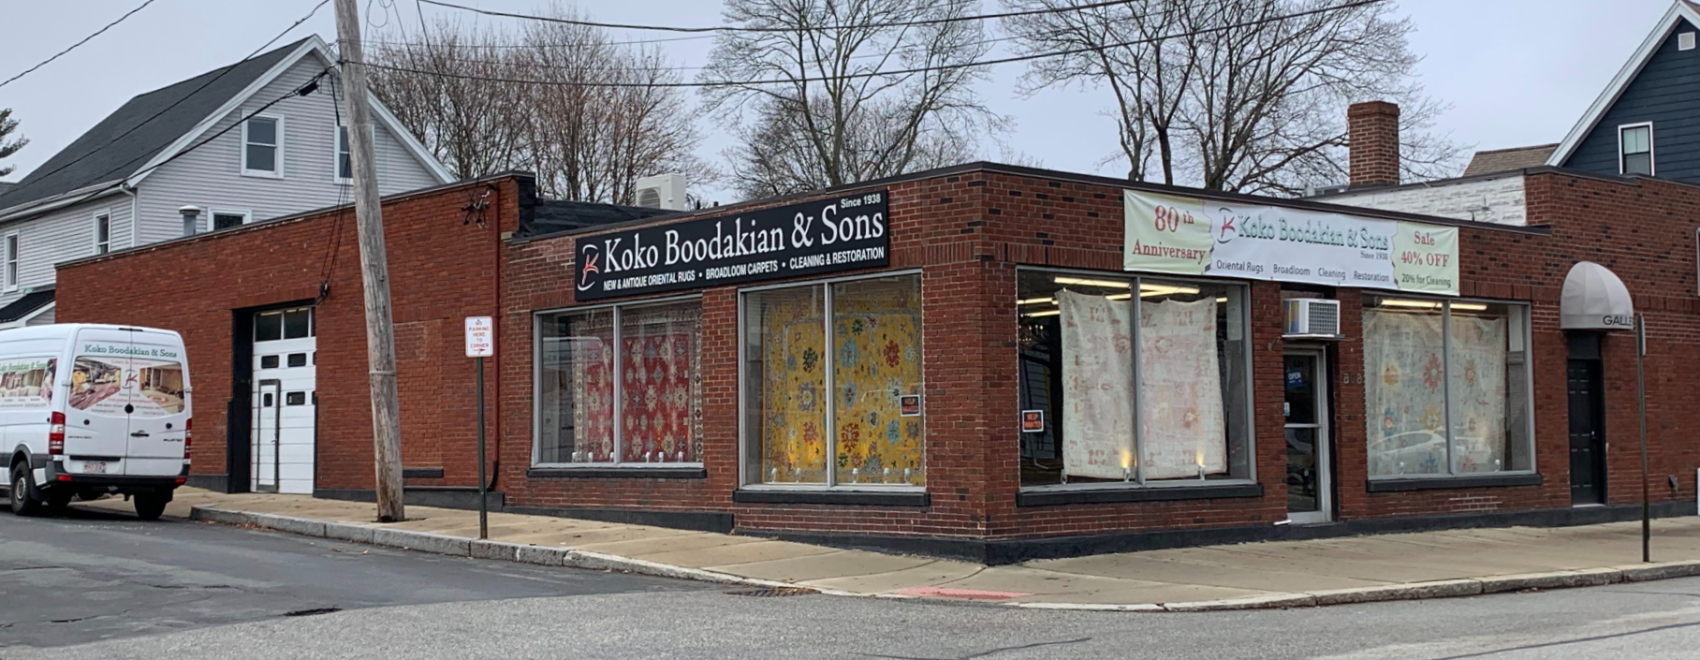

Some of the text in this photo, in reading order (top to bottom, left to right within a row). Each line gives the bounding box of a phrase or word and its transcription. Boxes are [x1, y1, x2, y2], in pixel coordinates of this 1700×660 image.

[840, 193, 881, 209] Since 1938
[1154, 205, 1195, 232] 80 th
[604, 204, 884, 274] Koko Boodakian & Sons
[1238, 214, 1389, 251] Koko Boodakian & Sons
[1413, 230, 1435, 246] Sale
[1132, 239, 1206, 265] Anniversary
[1360, 251, 1374, 260] Since
[1401, 250, 1449, 268] 40% OFF
[603, 246, 884, 291] NEW & ANTIQUE ORIENTAL RUGS BROADLOOM CARPETS CLEANING & RESTORATION
[1216, 259, 1389, 282] Oriental Rugs Broadloom Cleaning Restoration
[1402, 273, 1451, 288] 20% for Cleaning
[84, 344, 177, 358] Koko Boodakian & Sons
[1288, 371, 1302, 381] OPEN
[1343, 372, 1362, 384] 88
